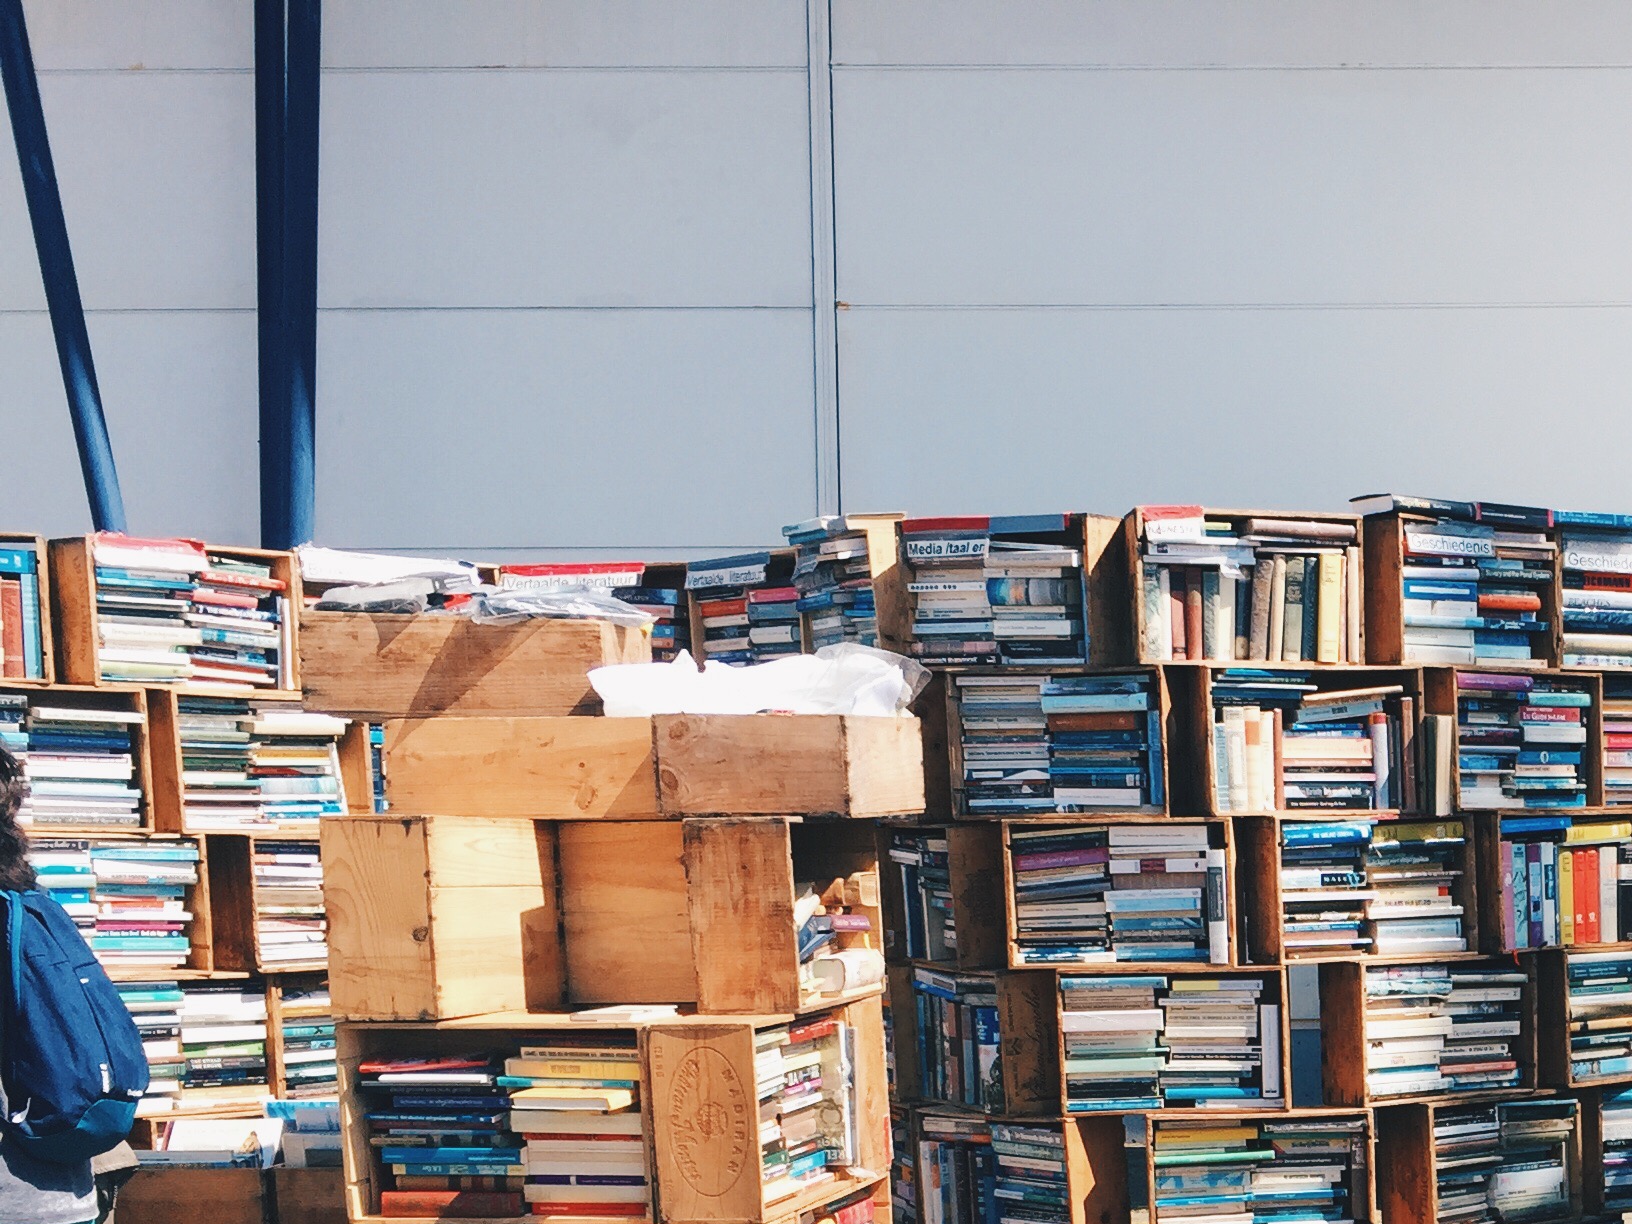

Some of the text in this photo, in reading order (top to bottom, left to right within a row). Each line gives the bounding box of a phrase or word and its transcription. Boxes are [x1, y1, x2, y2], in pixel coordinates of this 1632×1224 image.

[908, 540, 942, 555] Media
[1410, 534, 1491, 555] Geschiedenis
[576, 574, 634, 588] literatuur
